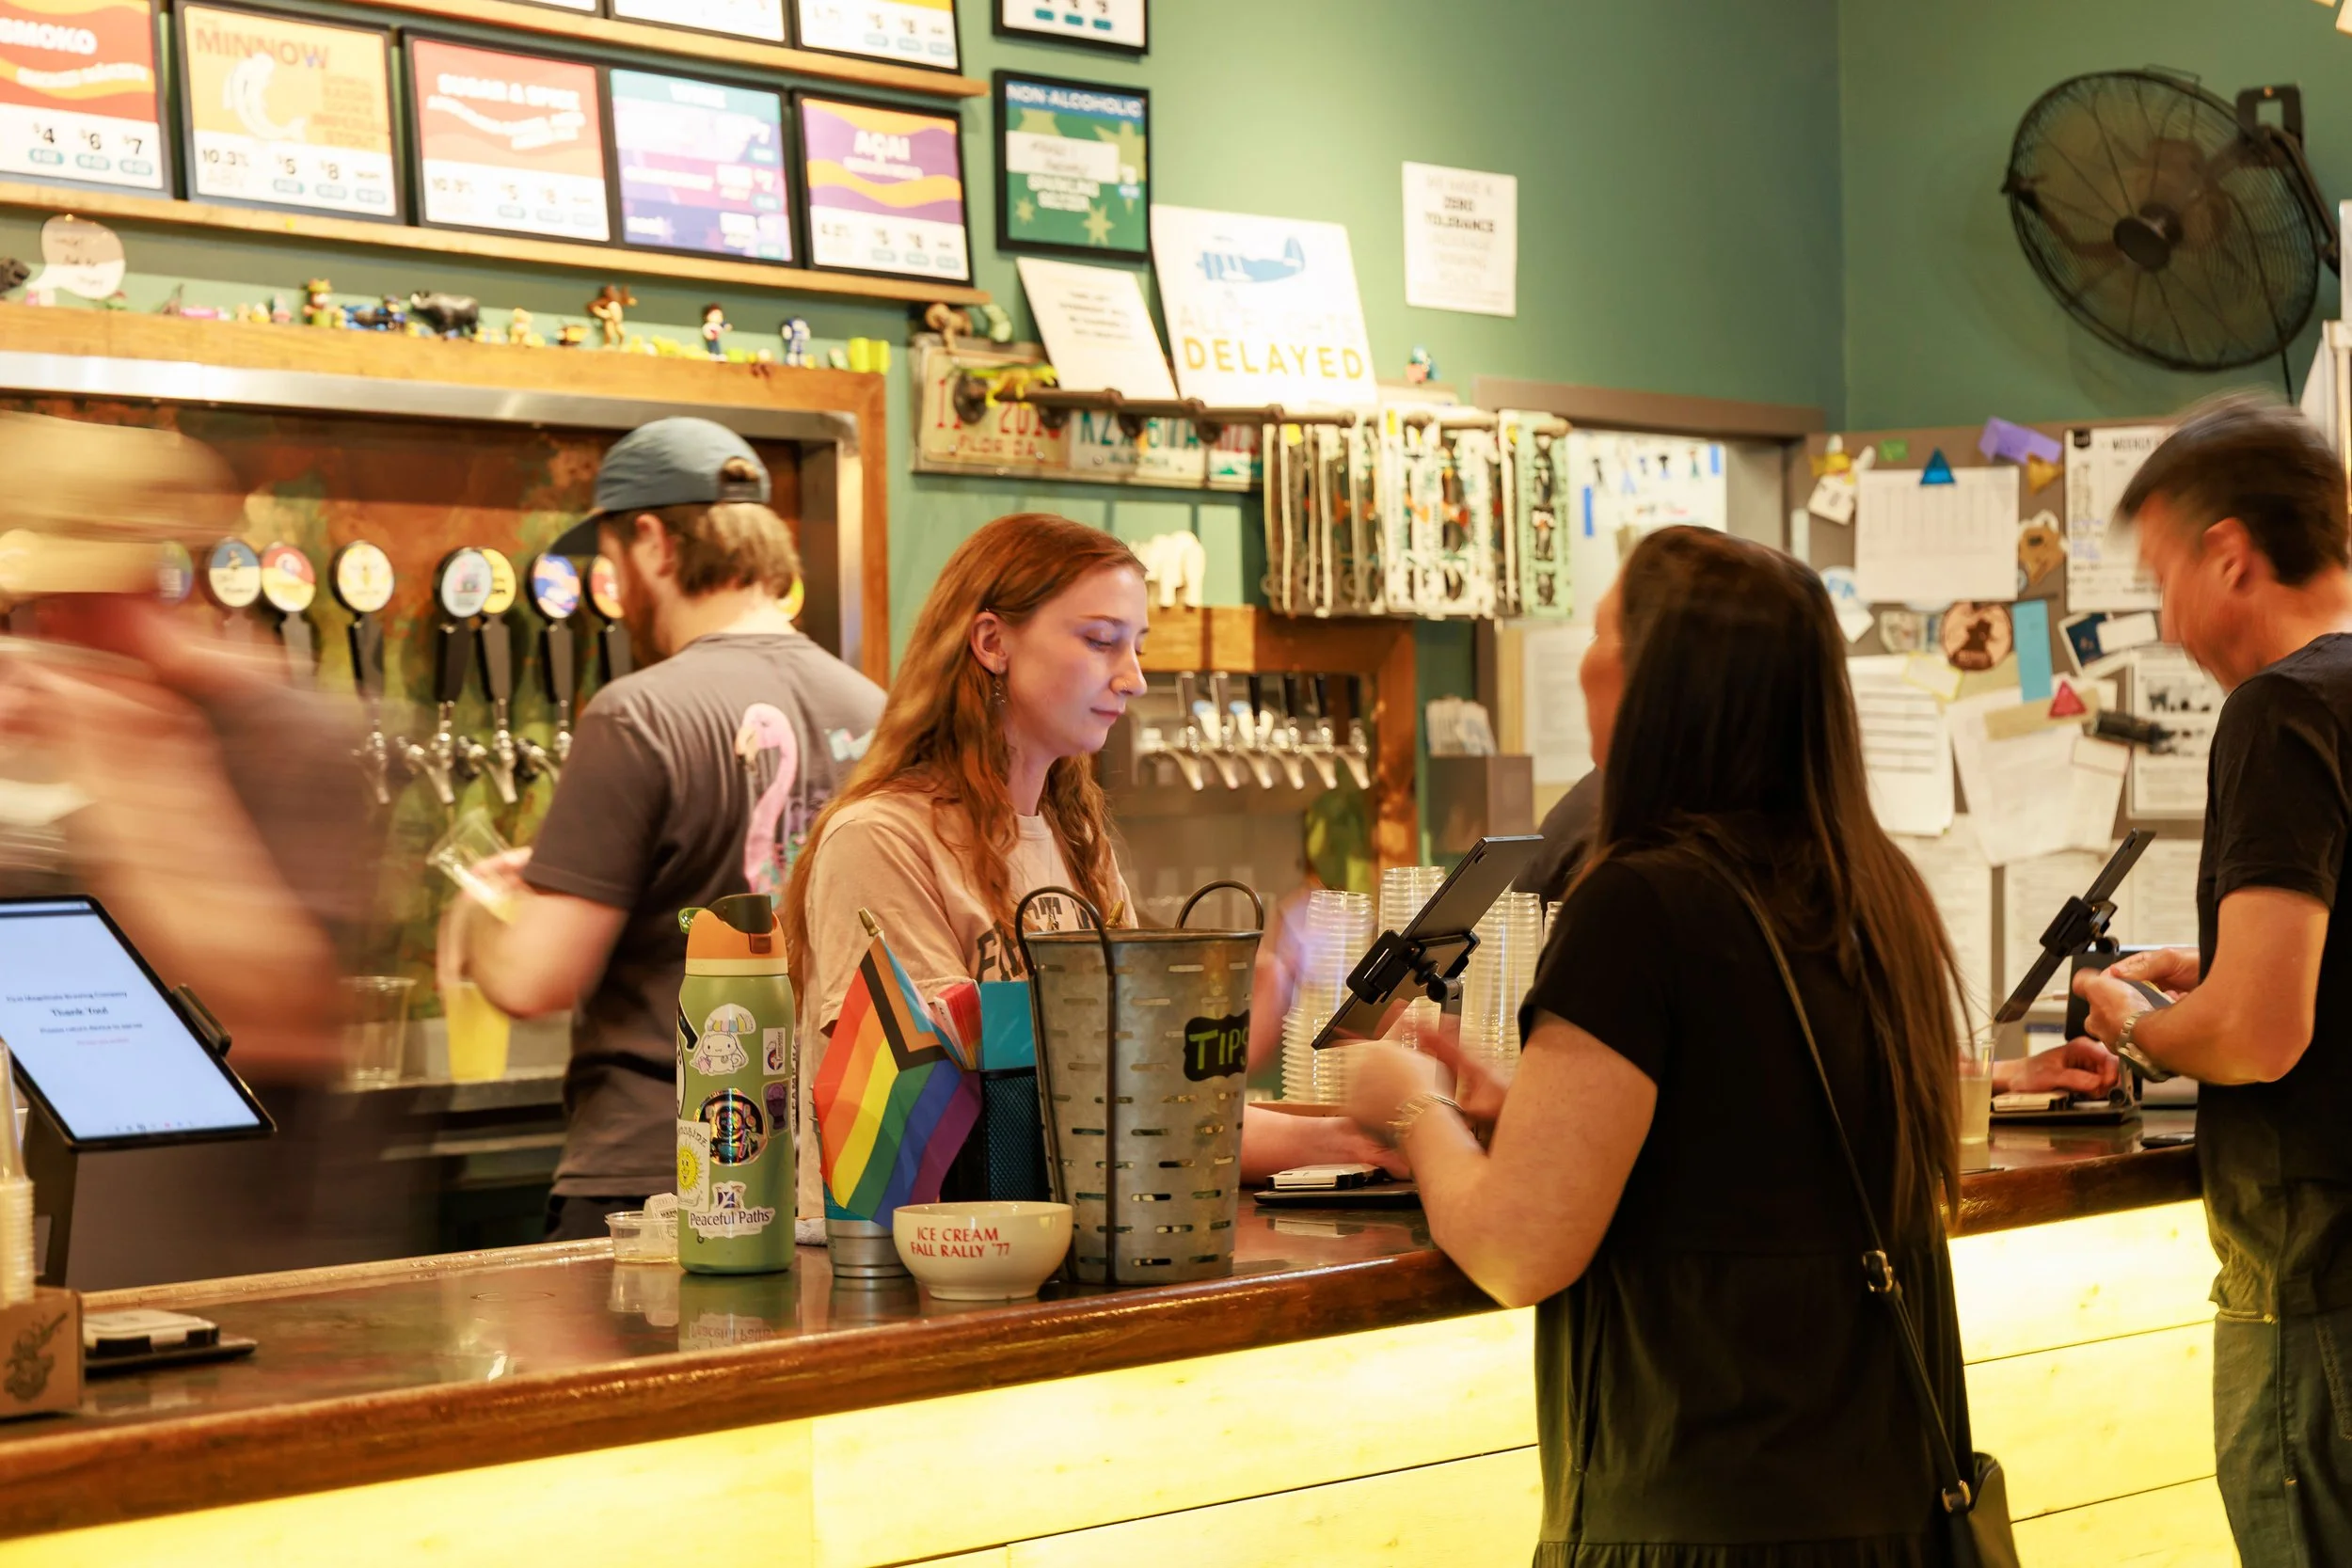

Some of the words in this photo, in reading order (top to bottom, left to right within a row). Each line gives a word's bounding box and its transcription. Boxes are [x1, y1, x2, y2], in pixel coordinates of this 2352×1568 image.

[196, 27, 329, 69] MINNOW
[1182, 335, 1365, 381] DELAYED
[690, 1211, 736, 1227] Peaceful
[739, 1209, 770, 1225] Paths
[917, 1227, 936, 1242] ICE
[942, 1227, 999, 1243] CREAM
[911, 1242, 936, 1257] FALL
[941, 1243, 987, 1259] RALLY
[992, 1243, 1011, 1257] '77
